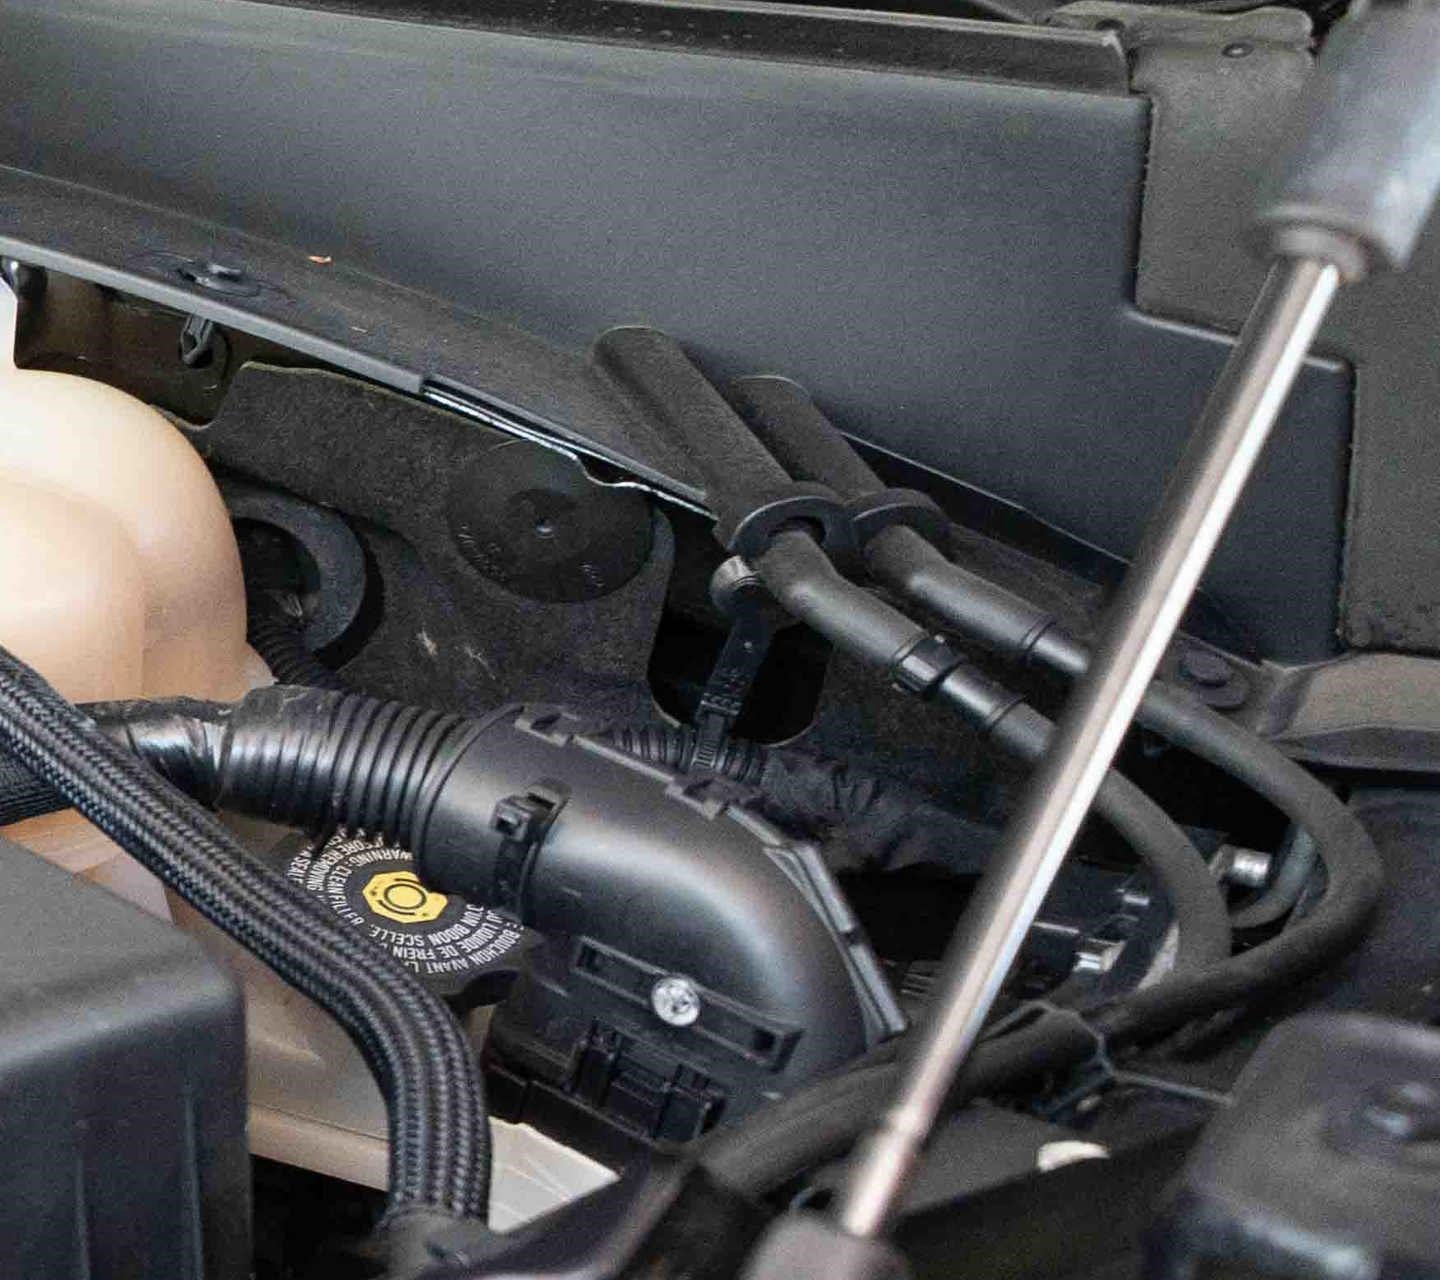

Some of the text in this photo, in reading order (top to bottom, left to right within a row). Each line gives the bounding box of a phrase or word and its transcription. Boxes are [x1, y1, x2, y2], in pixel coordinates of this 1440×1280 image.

[392, 945, 436, 960] FREIN
[435, 945, 460, 959] DE
[467, 928, 522, 966] BOUCHON
[425, 958, 470, 974] AVANT
